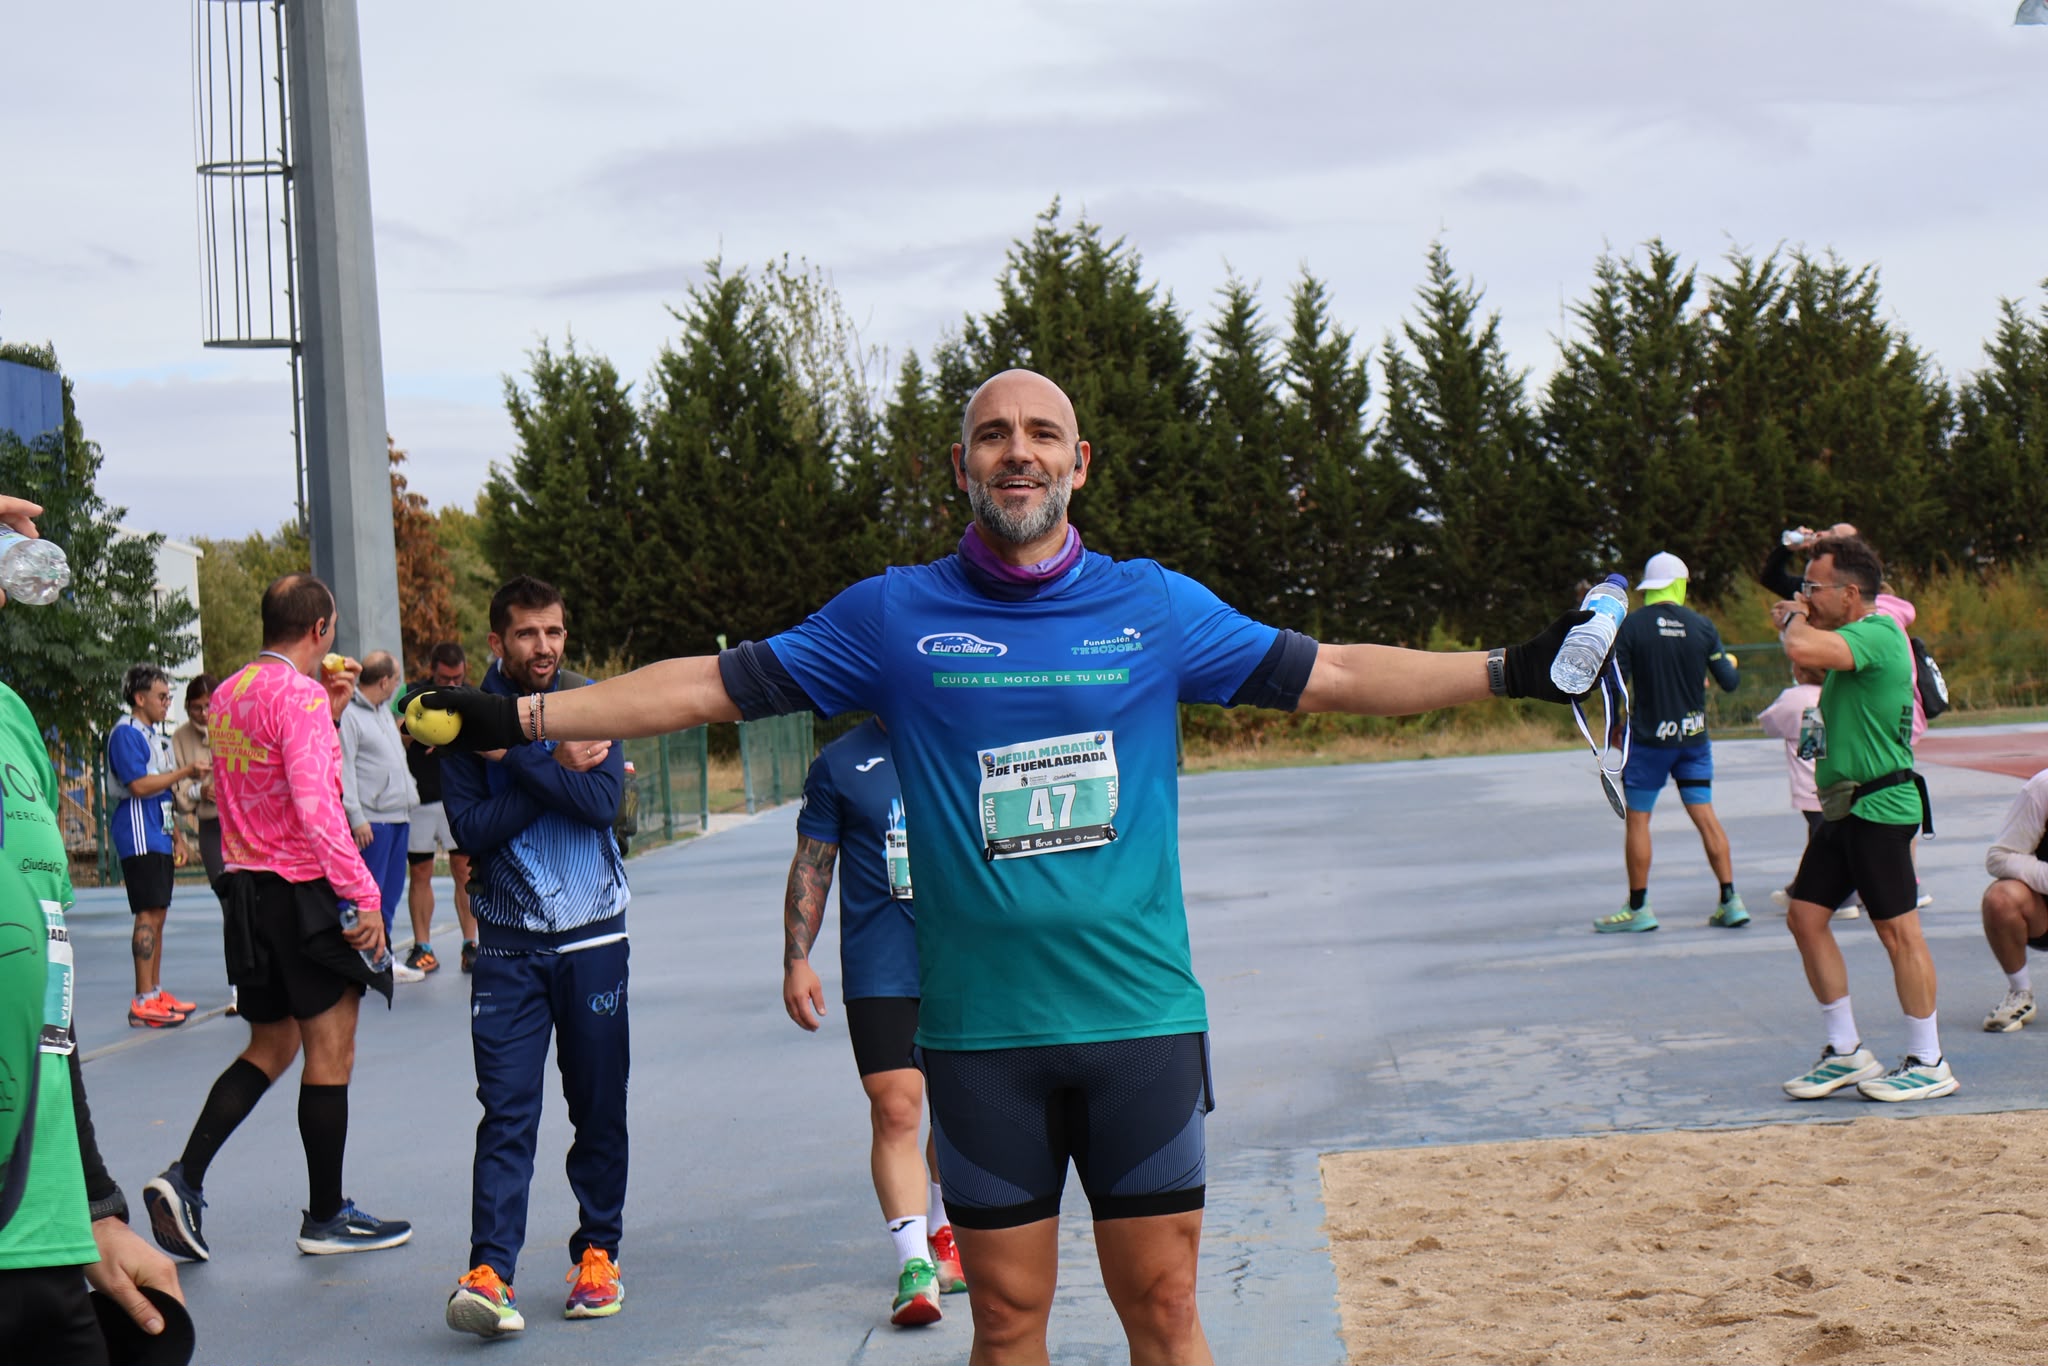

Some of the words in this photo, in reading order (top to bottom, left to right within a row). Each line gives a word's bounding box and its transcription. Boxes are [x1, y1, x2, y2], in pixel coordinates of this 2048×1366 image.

[931, 641, 994, 653] EuroTaller
[1071, 642, 1143, 655] THEODORA
[1083, 636, 1130, 646] Fundación
[941, 676, 979, 684] CUIDA
[984, 676, 998, 684] EL
[1004, 675, 1049, 683] MOTOR
[1055, 674, 1071, 682] DE
[1076, 674, 1090, 682] TU
[1096, 673, 1123, 681] VIDA
[996, 750, 1036, 767] MEDIA
[1038, 738, 1102, 757] MARATÓN
[995, 766, 1011, 777] DE
[1013, 751, 1108, 774] FUENLABRADA
[985, 797, 998, 834] MEDIA
[1027, 783, 1077, 831] 47
